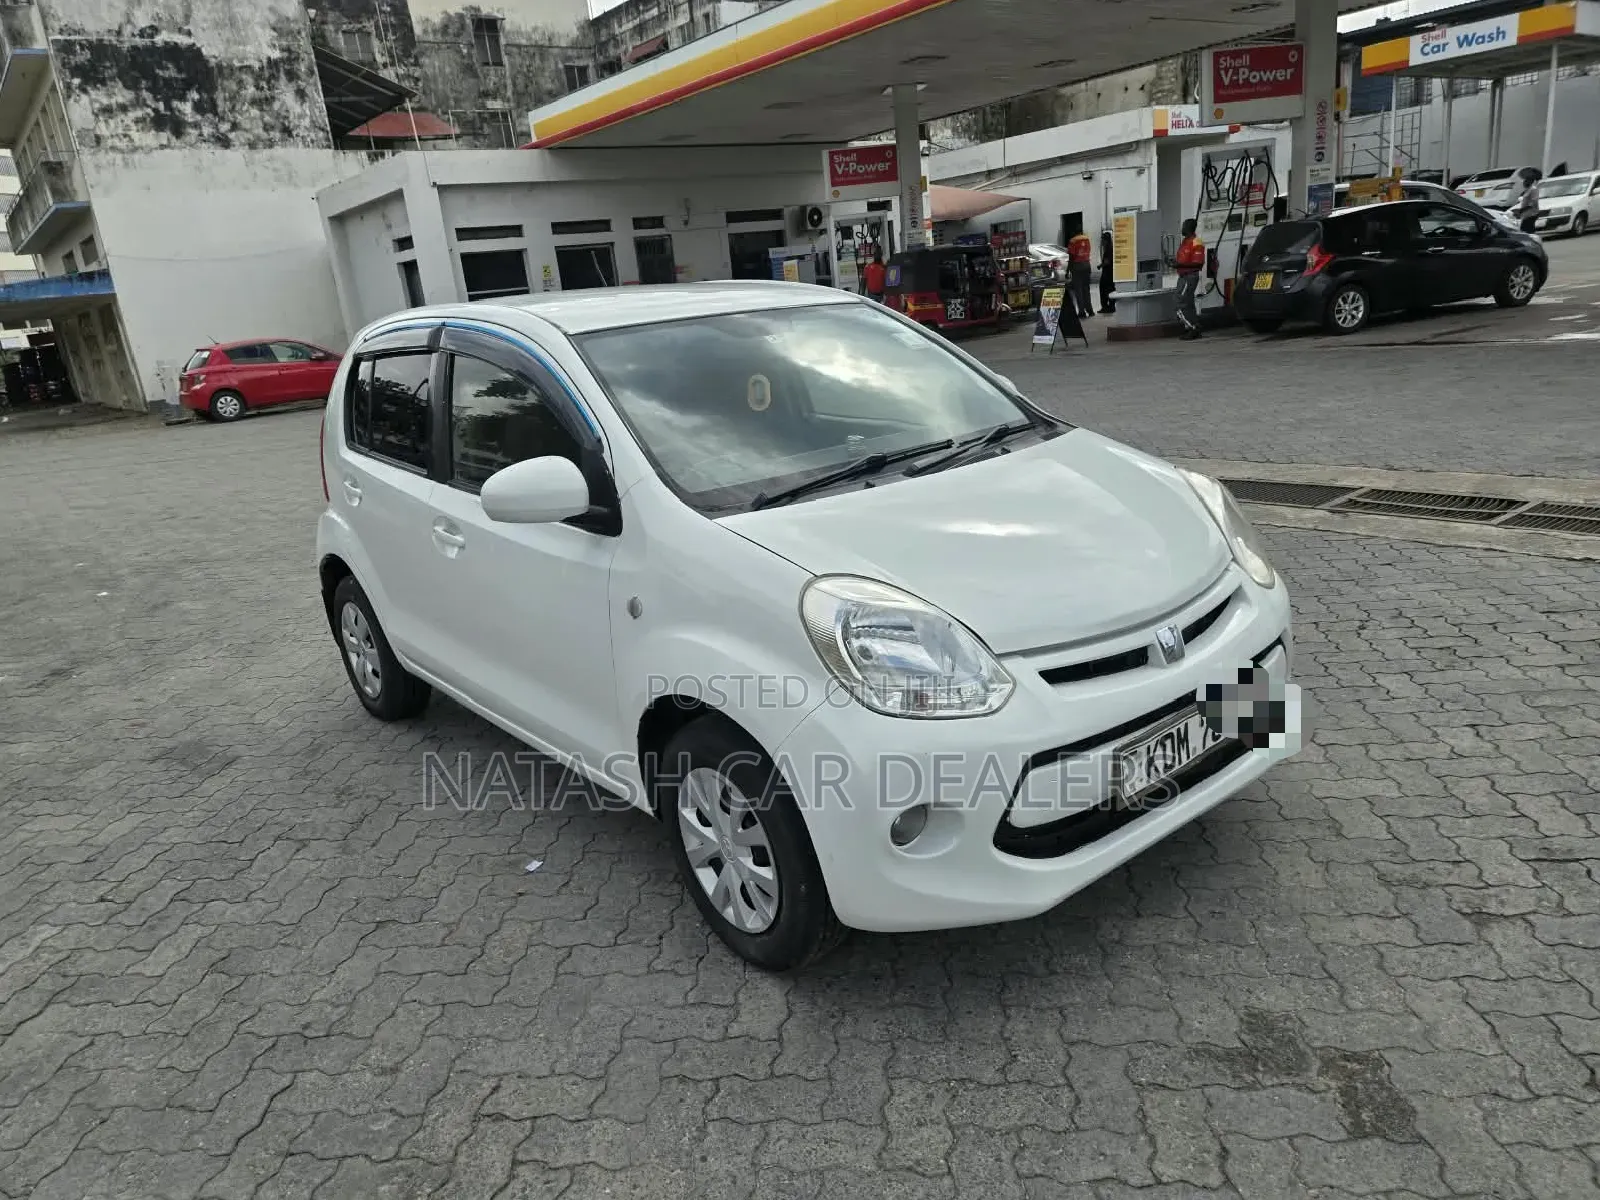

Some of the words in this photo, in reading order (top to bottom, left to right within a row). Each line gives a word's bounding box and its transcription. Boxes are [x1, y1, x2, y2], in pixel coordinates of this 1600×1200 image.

[1420, 40, 1450, 57] Car
[1456, 26, 1507, 50] Wash
[1421, 28, 1447, 43] Shell
[1219, 54, 1250, 69] Shell
[1220, 67, 1295, 86] V-Power
[1171, 119, 1195, 130] HELIX
[833, 152, 857, 163] Shell
[835, 160, 892, 175] V-Power
